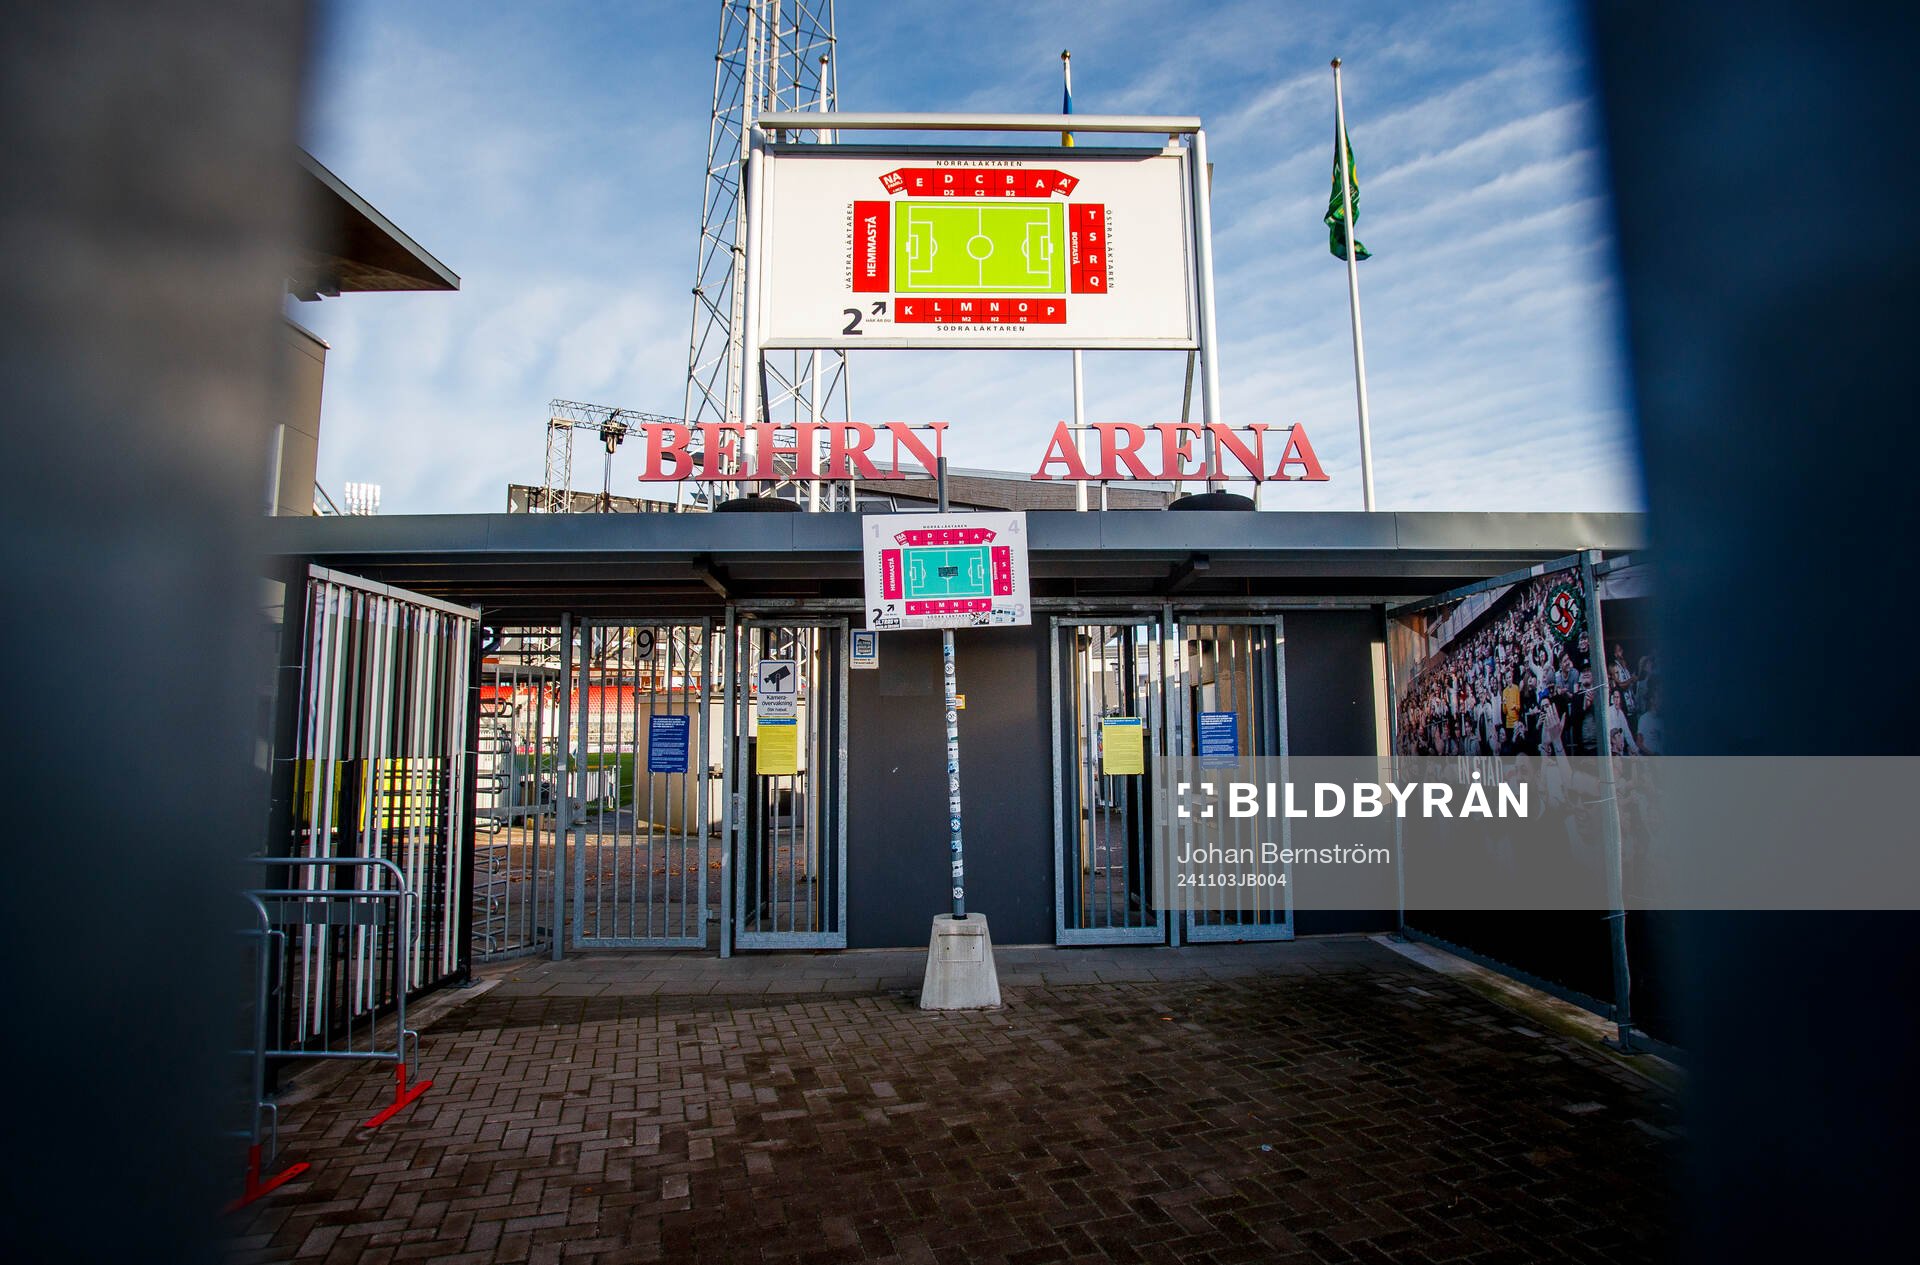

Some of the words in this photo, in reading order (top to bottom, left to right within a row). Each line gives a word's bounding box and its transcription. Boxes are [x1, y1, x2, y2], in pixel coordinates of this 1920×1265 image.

[883, 172, 902, 185] NA
[916, 178, 924, 187] E
[944, 174, 954, 184] D
[975, 175, 984, 184] C
[1006, 175, 1014, 184] B
[1035, 179, 1045, 188] A
[1088, 210, 1096, 220] T
[1089, 232, 1097, 242] S
[864, 216, 877, 277] HEMMASTÅ
[1089, 255, 1098, 264] R
[1089, 276, 1099, 287] Q
[904, 306, 913, 315] K
[934, 302, 941, 311] L
[960, 302, 972, 311] M
[990, 302, 999, 311] N
[1018, 302, 1028, 312] O
[1047, 306, 1055, 316] P
[842, 308, 863, 335] 2
[638, 421, 948, 482] BEHRN
[1030, 421, 1330, 482] ARENA
[871, 523, 879, 538] 1
[1008, 520, 1020, 534] 4
[1015, 603, 1024, 618] 3
[637, 629, 654, 658] 9
